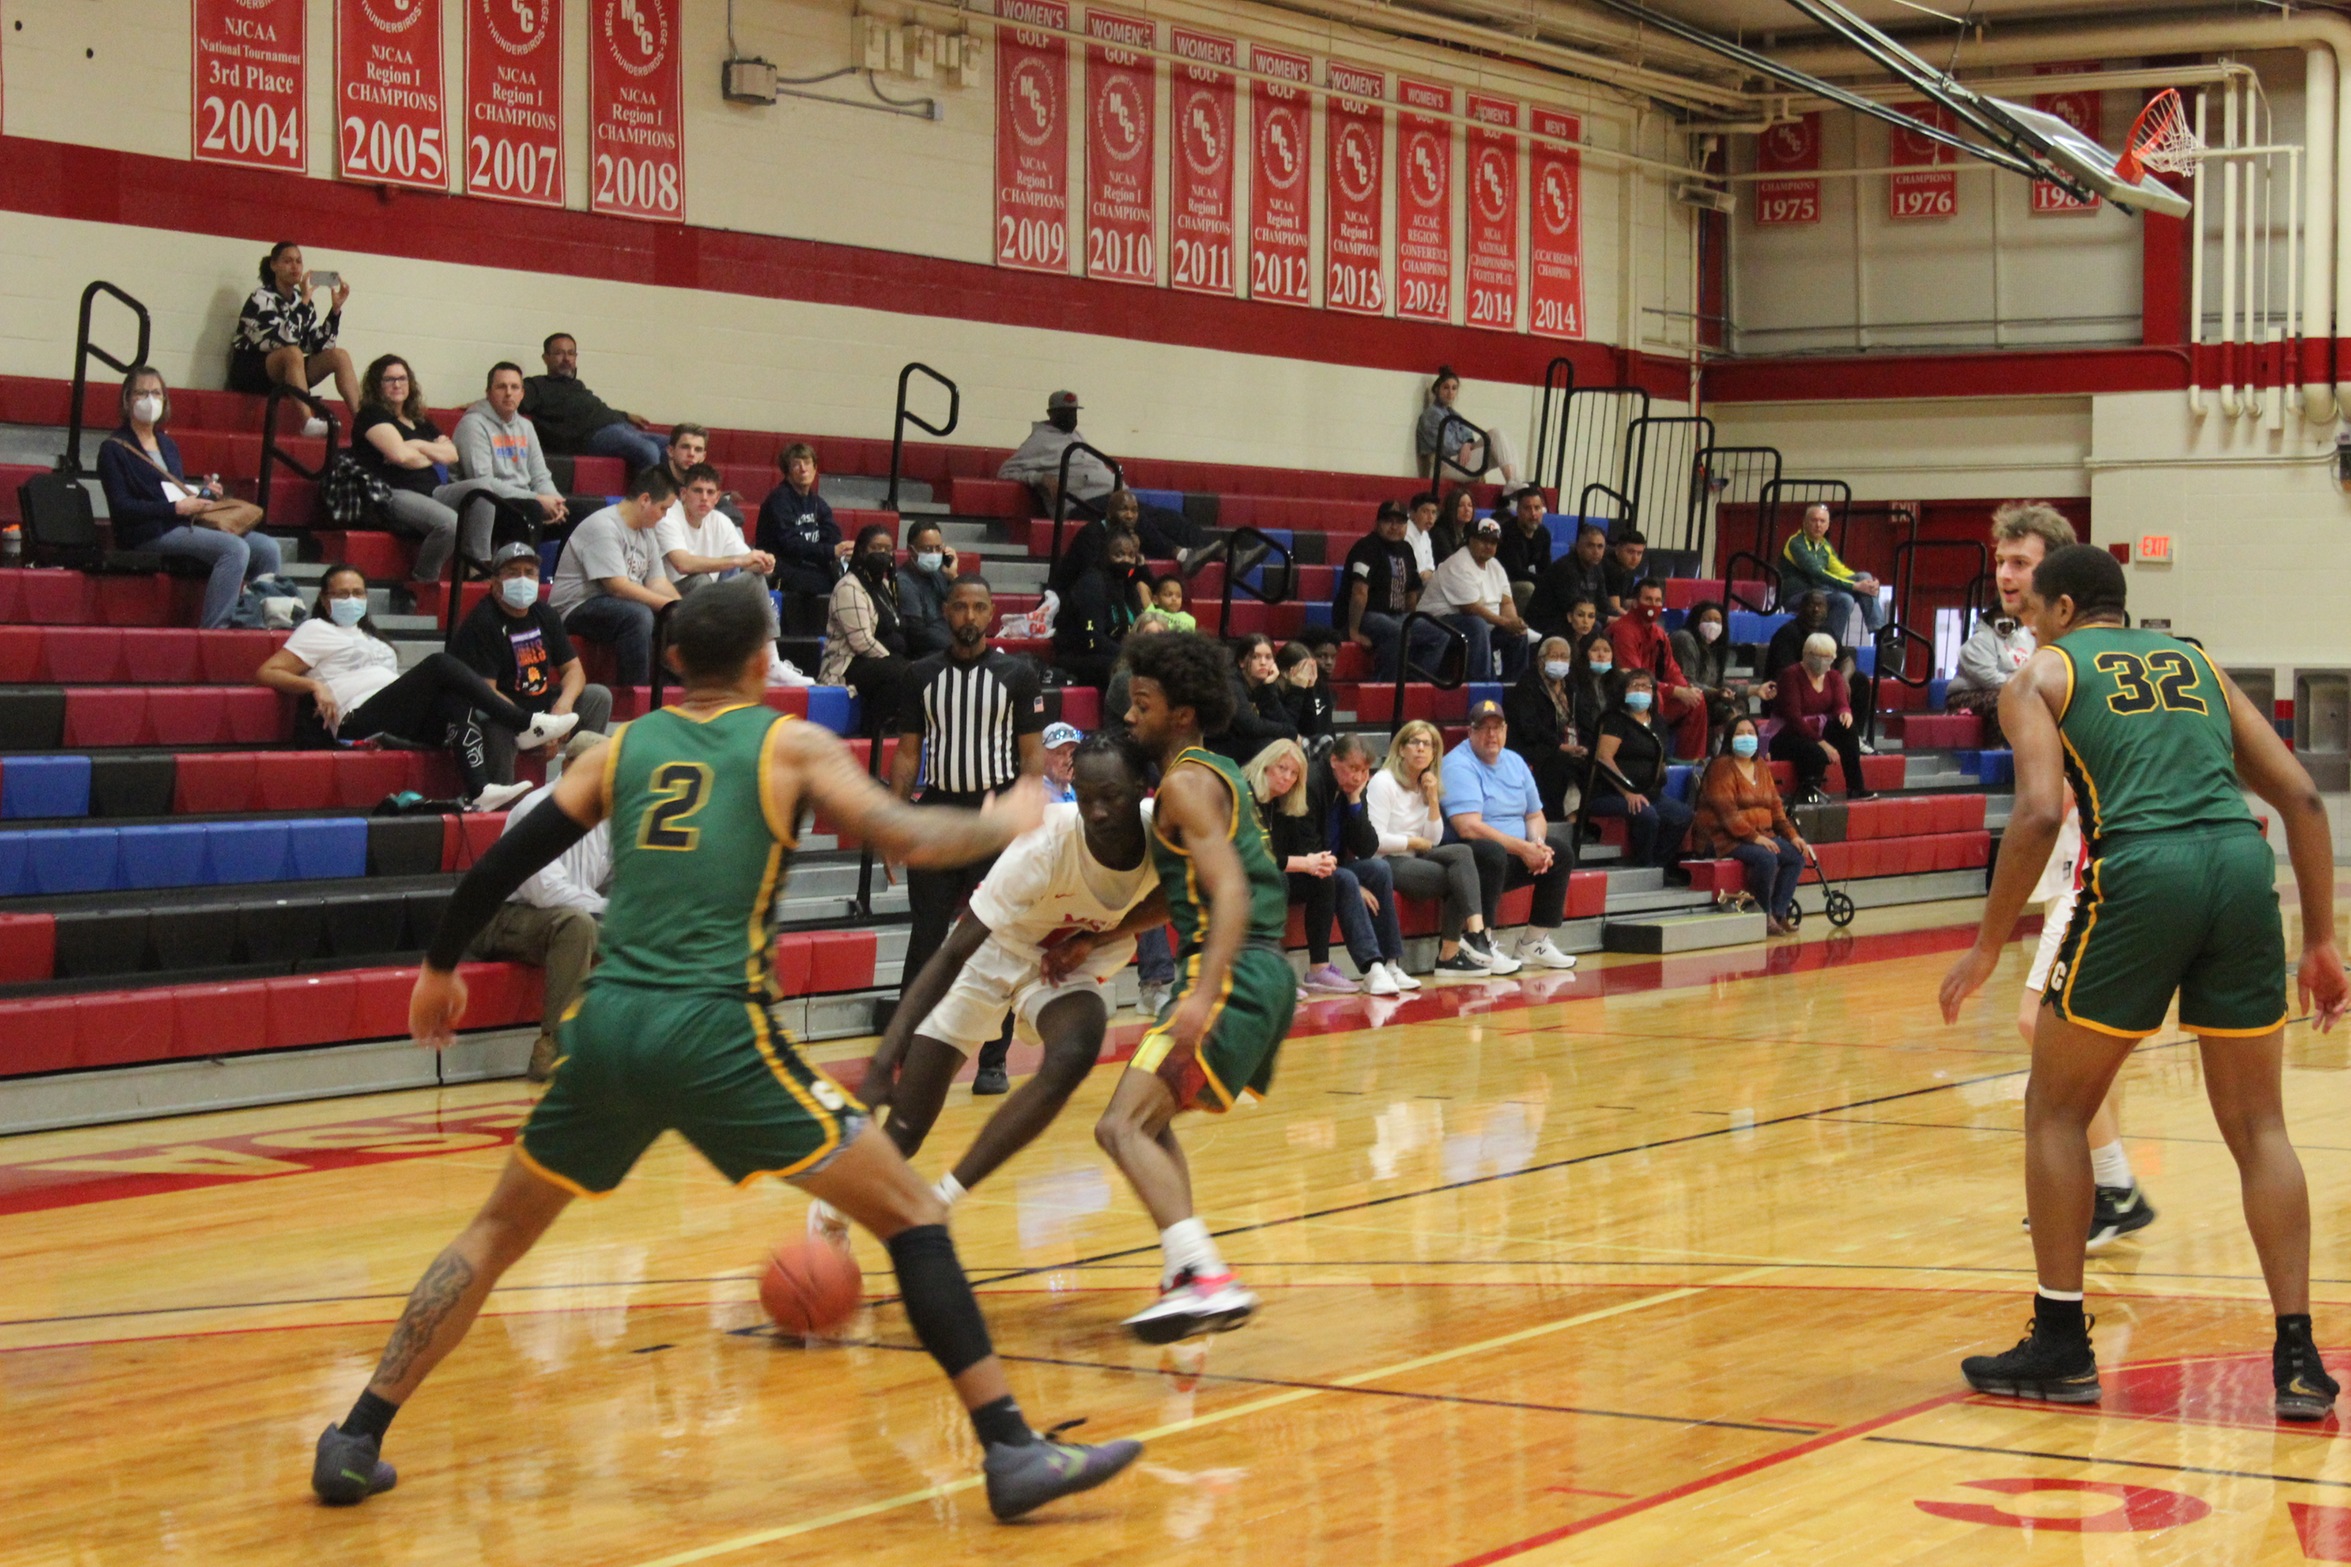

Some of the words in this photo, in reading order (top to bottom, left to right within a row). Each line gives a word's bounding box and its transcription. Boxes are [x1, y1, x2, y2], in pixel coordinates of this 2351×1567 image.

[605, 3, 614, 37] MESA
[621, 0, 653, 55] MCC
[654, 0, 668, 46] OLLEGE
[1002, 1, 1064, 29] WOMEN'S
[225, 17, 276, 42] NJCAA
[487, 21, 545, 55] THUNDERBIRDS
[200, 38, 240, 57] National
[244, 44, 300, 65] Tournament
[371, 44, 412, 65] NJCAA
[609, 44, 664, 76] THUNDERBIRDS
[1176, 36, 1232, 66] WOMEN'S
[209, 60, 240, 87] 3rd
[246, 65, 294, 94] Place
[366, 61, 411, 86] Region
[497, 65, 536, 86] NJCAA
[1256, 53, 1308, 82] WOMEN'S
[347, 82, 437, 112] CHAMPIONS
[492, 82, 534, 107] Region
[620, 87, 656, 106] NJCAA
[1331, 71, 1380, 97] WOMEN'S
[1020, 75, 1047, 128] MCC
[1407, 87, 1444, 109] WOMEN'S
[201, 96, 299, 159] 2004
[474, 102, 556, 131] CHAMPIONS
[612, 103, 654, 126] Region
[1110, 92, 1135, 143] MCC
[1545, 119, 1567, 137] MEN'S
[598, 123, 676, 150] CHAMPIONS
[1193, 108, 1216, 158] MCC
[344, 116, 442, 180] 2005
[1271, 124, 1293, 173] MCC
[1347, 138, 1367, 185] MCC
[470, 135, 557, 197] 2007
[1020, 155, 1047, 172] NJCAA
[1416, 146, 1436, 191] MCC
[597, 153, 679, 212] 2008
[1017, 170, 1046, 190] Region
[1109, 170, 1137, 186] NJCAA
[1484, 162, 1502, 206] MCC
[1761, 181, 1816, 192] CHAMPIONS
[1896, 173, 1950, 185] CHAMPIONS
[1001, 187, 1065, 210] CHAMPIONS
[1103, 184, 1135, 204] Region
[1191, 184, 1218, 200] NJCAA
[1269, 198, 1294, 213] NJCAA
[1547, 176, 1564, 219] MCC
[1897, 191, 1951, 214] 1976
[1093, 202, 1150, 223] CHAMPIONS
[1188, 197, 1217, 215] Region
[1345, 210, 1369, 225] NJCAA
[1761, 198, 1814, 221] 1975
[1178, 214, 1231, 236] CHAMPIONS
[1266, 211, 1293, 229] Region
[1341, 223, 1367, 241] Region
[1412, 214, 1440, 229] ACCAC
[1000, 215, 1065, 265] 2009
[1254, 227, 1307, 248] CHAMPIONS
[1333, 239, 1380, 258] CHAMPIONS
[1408, 228, 1439, 244] REGION
[1090, 227, 1153, 277] 2010
[1175, 239, 1232, 289] 2011
[1401, 243, 1448, 262] CONFERENCE
[1254, 251, 1308, 298] 2012
[1403, 259, 1447, 277] CHAMPIONS
[1331, 263, 1382, 309] 2013
[1404, 279, 1447, 314] 2014
[1472, 289, 1512, 323] 2014
[1535, 298, 1576, 332] 2014
[2142, 536, 2169, 556] EXIT
[2094, 650, 2209, 716] 32
[638, 761, 715, 851] 2
